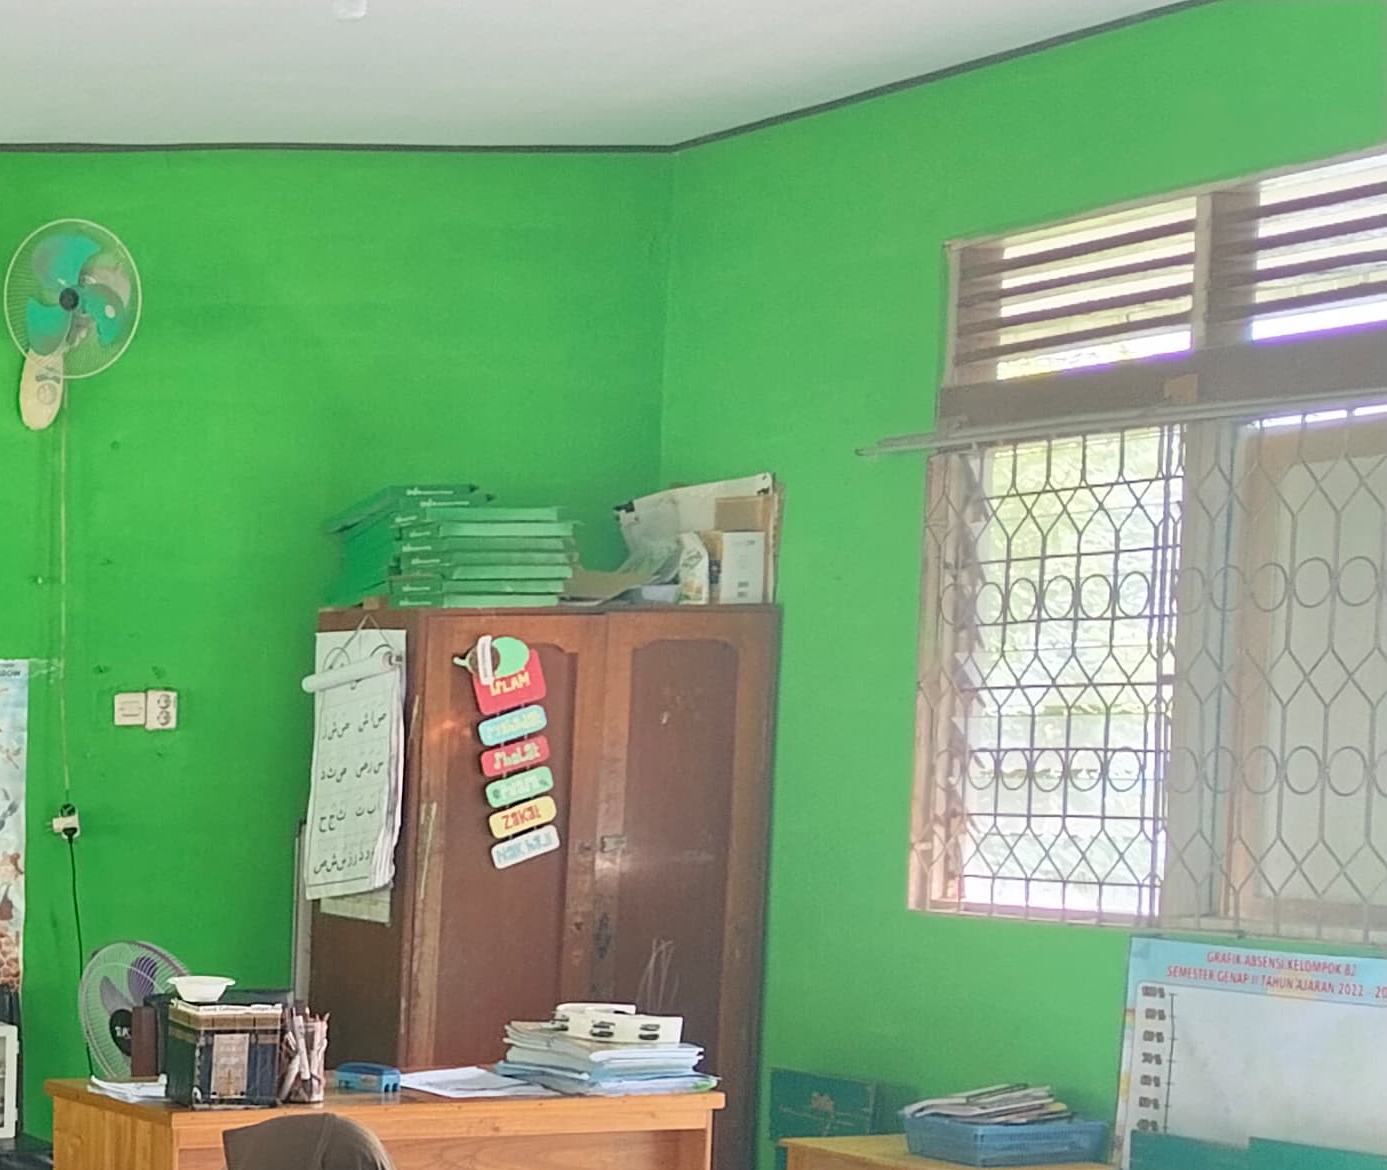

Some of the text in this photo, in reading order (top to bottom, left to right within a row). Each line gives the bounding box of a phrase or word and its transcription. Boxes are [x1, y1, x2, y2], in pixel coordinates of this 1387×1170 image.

[501, 804, 542, 831] Zakat
[1206, 951, 1242, 965] GRAFIK
[1244, 954, 1285, 970] ABSENSI
[1287, 959, 1342, 976] KELOMPOK
[1166, 965, 1216, 981] SEMESTER
[1217, 969, 1250, 985] GENAP
[1260, 974, 1293, 990] TAHUN
[1294, 976, 1335, 994] AJARAN
[1338, 982, 1365, 997] 2022
